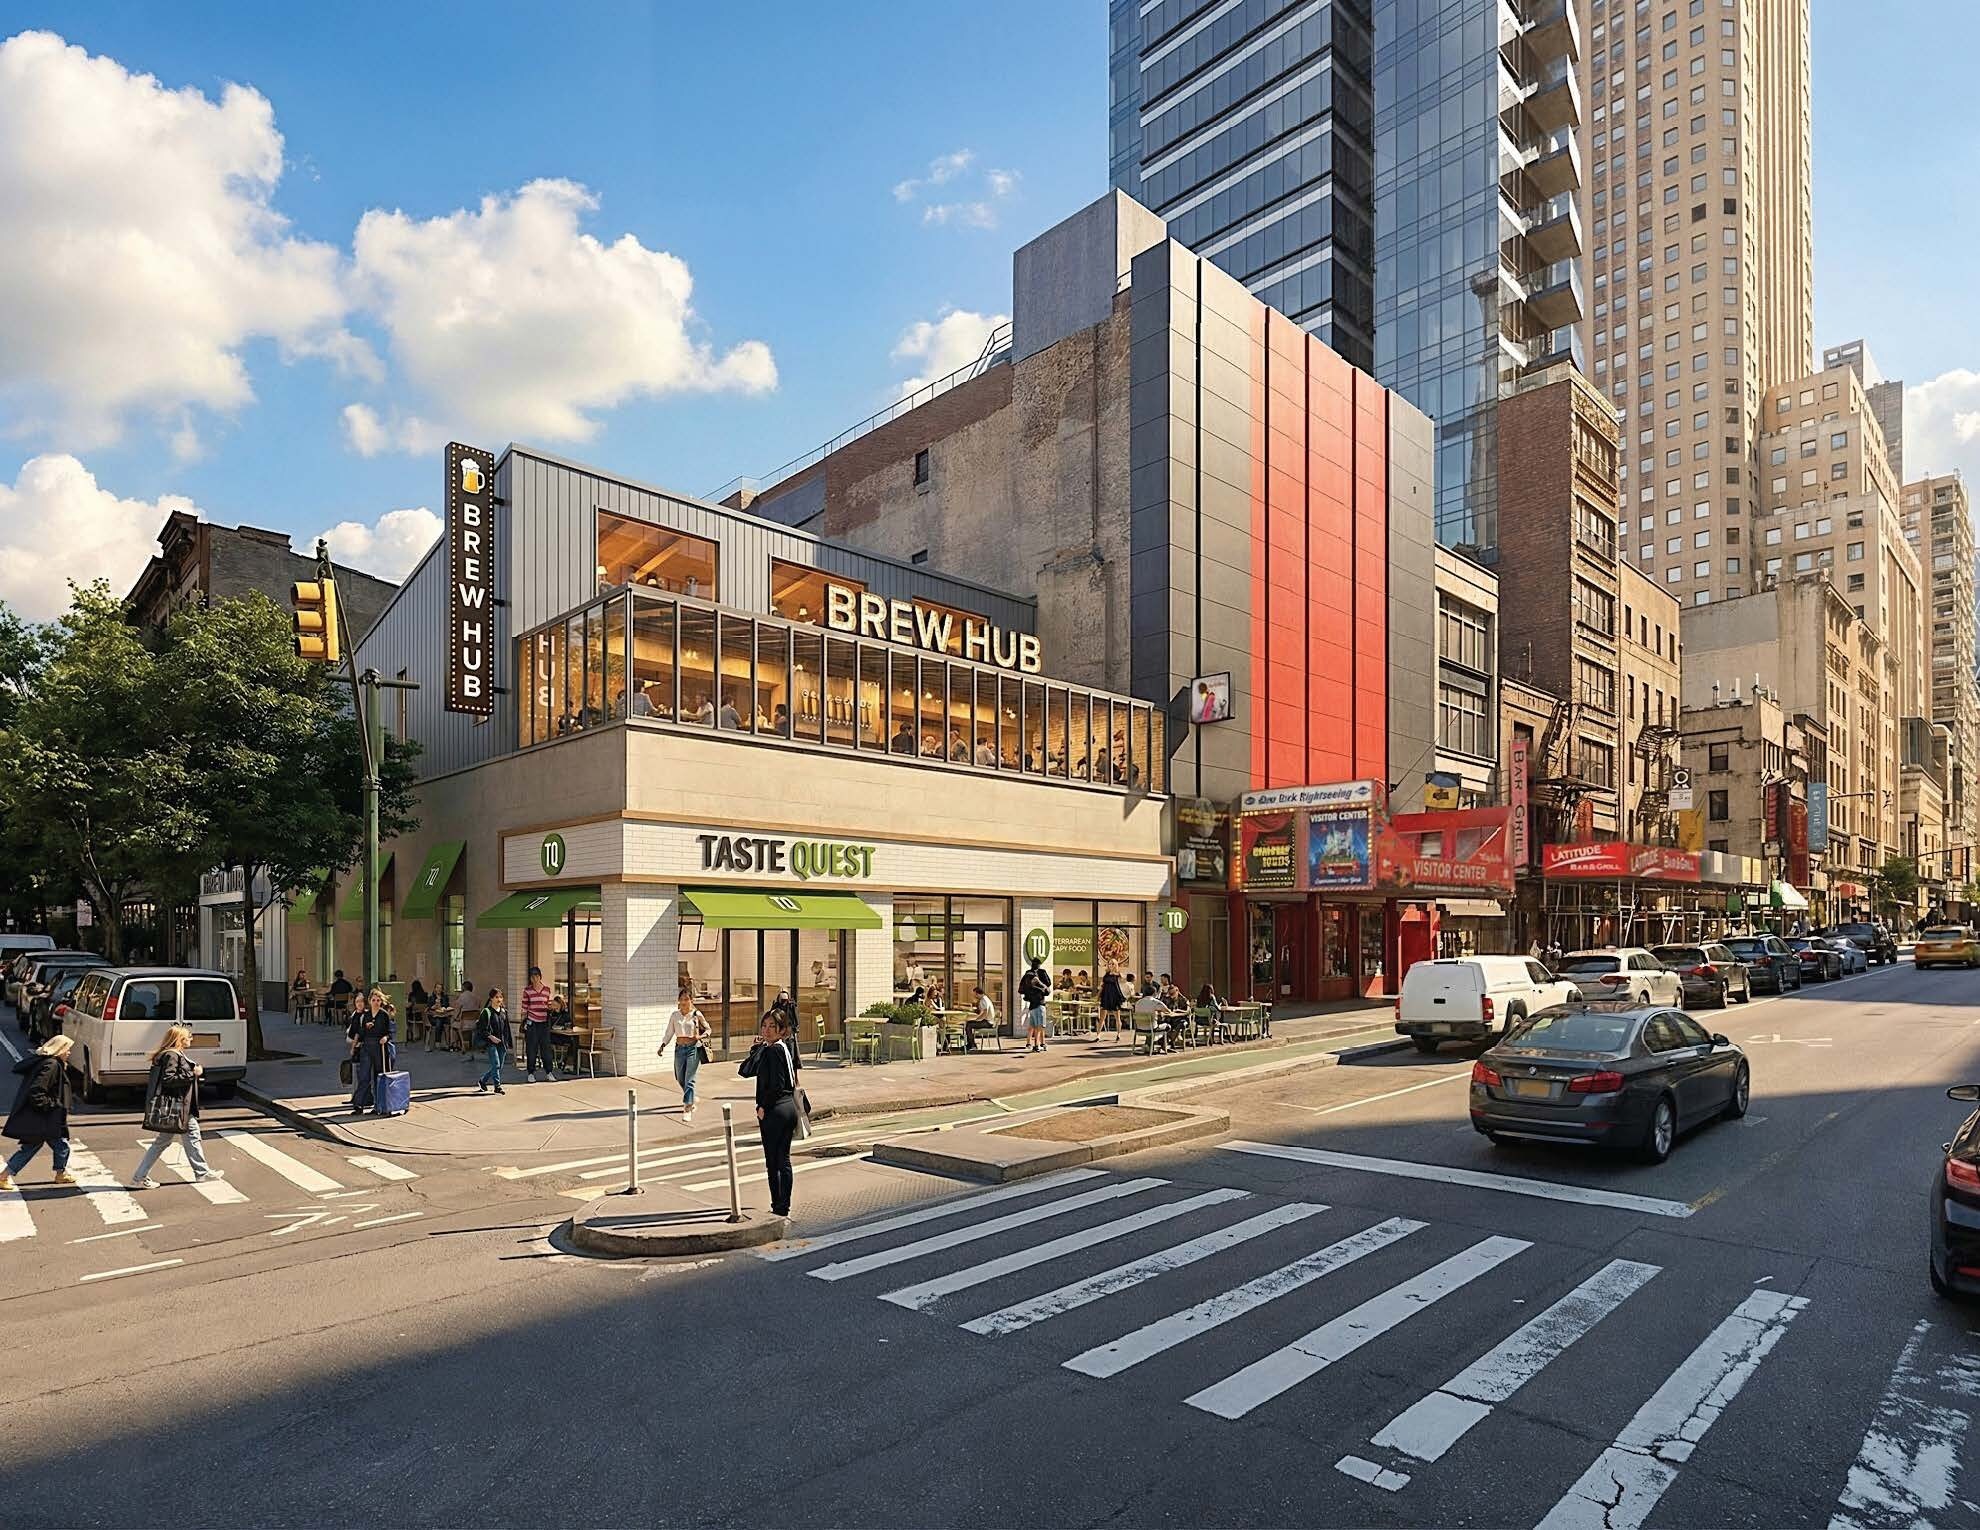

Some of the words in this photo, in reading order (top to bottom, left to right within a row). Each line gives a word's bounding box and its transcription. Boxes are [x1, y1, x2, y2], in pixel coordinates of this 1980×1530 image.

[458, 503, 486, 609] BREW
[827, 583, 954, 653] BREW
[965, 618, 1042, 674] HUB
[463, 622, 481, 698] HUB
[1513, 750, 1525, 790] BAR
[1310, 812, 1338, 823] VISITOR
[1338, 810, 1368, 820] CENTER
[544, 841, 559, 868] TQ
[697, 834, 786, 872] TASTE
[789, 841, 876, 881] QUEST
[1551, 844, 1602, 862] LATITUDE
[1413, 860, 1452, 879] VISITOR
[1453, 864, 1487, 880] CENTER
[768, 896, 801, 911] TQ
[1166, 911, 1183, 929] TQ
[1031, 935, 1047, 958] TQ
